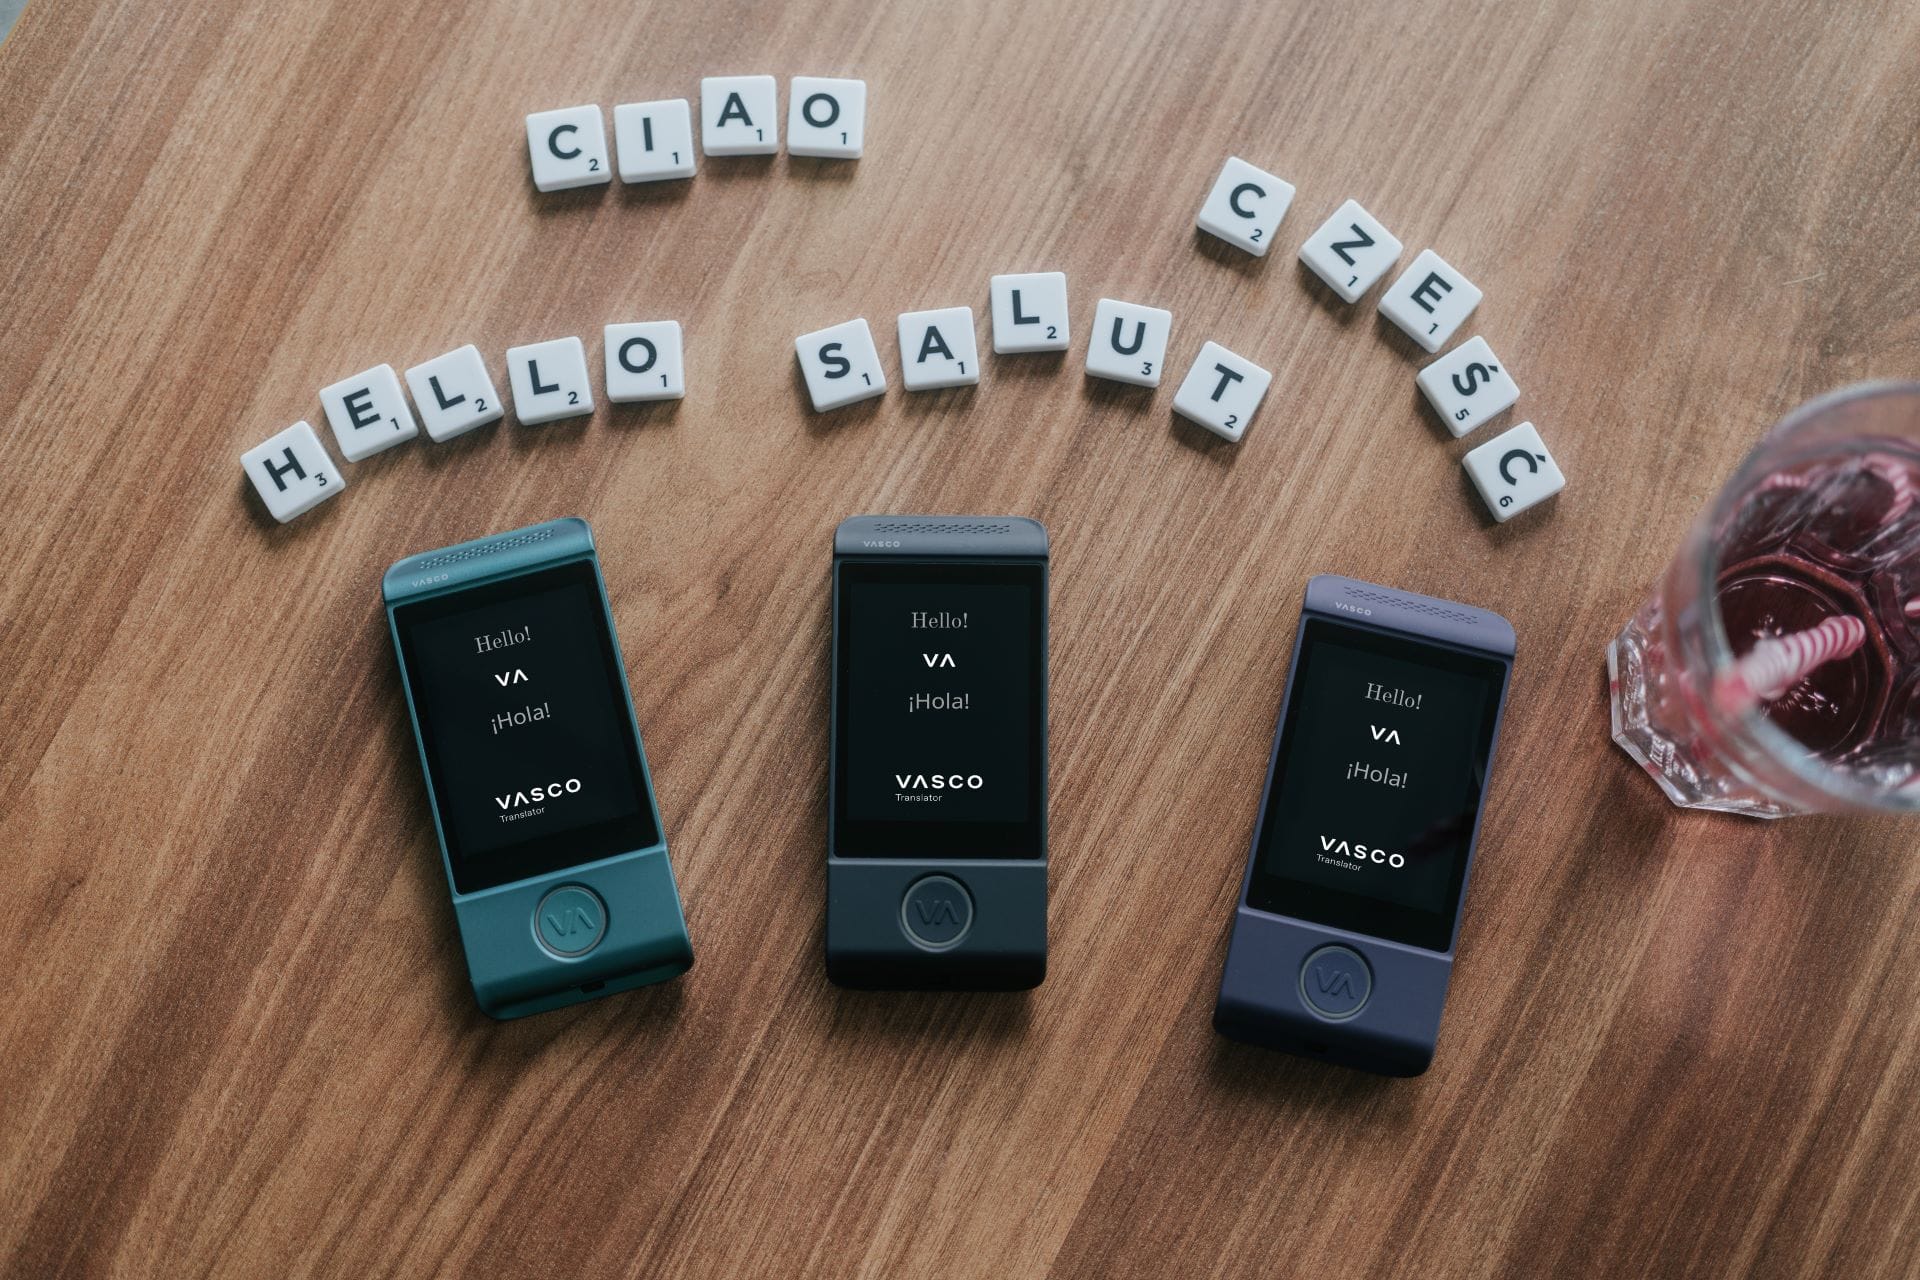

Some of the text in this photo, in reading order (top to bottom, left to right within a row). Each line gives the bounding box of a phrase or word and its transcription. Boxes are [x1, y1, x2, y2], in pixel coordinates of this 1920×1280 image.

[548, 92, 840, 160] CIAO
[756, 128, 763, 142] 1
[841, 132, 847, 145] 1
[589, 158, 600, 172] 2
[672, 151, 679, 165] 1
[1249, 228, 1263, 243] 2
[1347, 275, 1359, 288] 1
[1046, 325, 1057, 340] 2
[1229, 182, 1546, 487] CZEŚĆ
[1428, 322, 1439, 335] 1
[818, 289, 1244, 403] SALUT
[957, 361, 965, 375] 1
[1141, 361, 1153, 376] 3
[660, 374, 668, 388] 1
[861, 372, 871, 386] 1
[474, 398, 488, 413] 2
[567, 391, 579, 406] 2
[262, 336, 658, 493] HELLO
[1223, 414, 1238, 429] 2
[1455, 408, 1470, 421] 5
[390, 417, 400, 431] 1
[314, 472, 328, 487] 3
[1499, 495, 1514, 508] 6
[863, 540, 901, 548] VASCO
[411, 573, 449, 588] VASCO
[1335, 601, 1372, 616] VASCO
[911, 611, 968, 629] Hello!
[474, 625, 532, 654] Hello!
[908, 692, 970, 713] ¡Hola!
[1364, 681, 1422, 710] Hello!
[491, 702, 551, 735] ¡Hola!
[895, 774, 984, 790] VASCO
[1346, 761, 1408, 789] ¡Hola!
[495, 778, 582, 810] VASCO
[895, 793, 943, 802] Translator
[499, 805, 546, 824] Translator
[1320, 835, 1405, 869] VASCO
[1316, 853, 1362, 872] Translator
